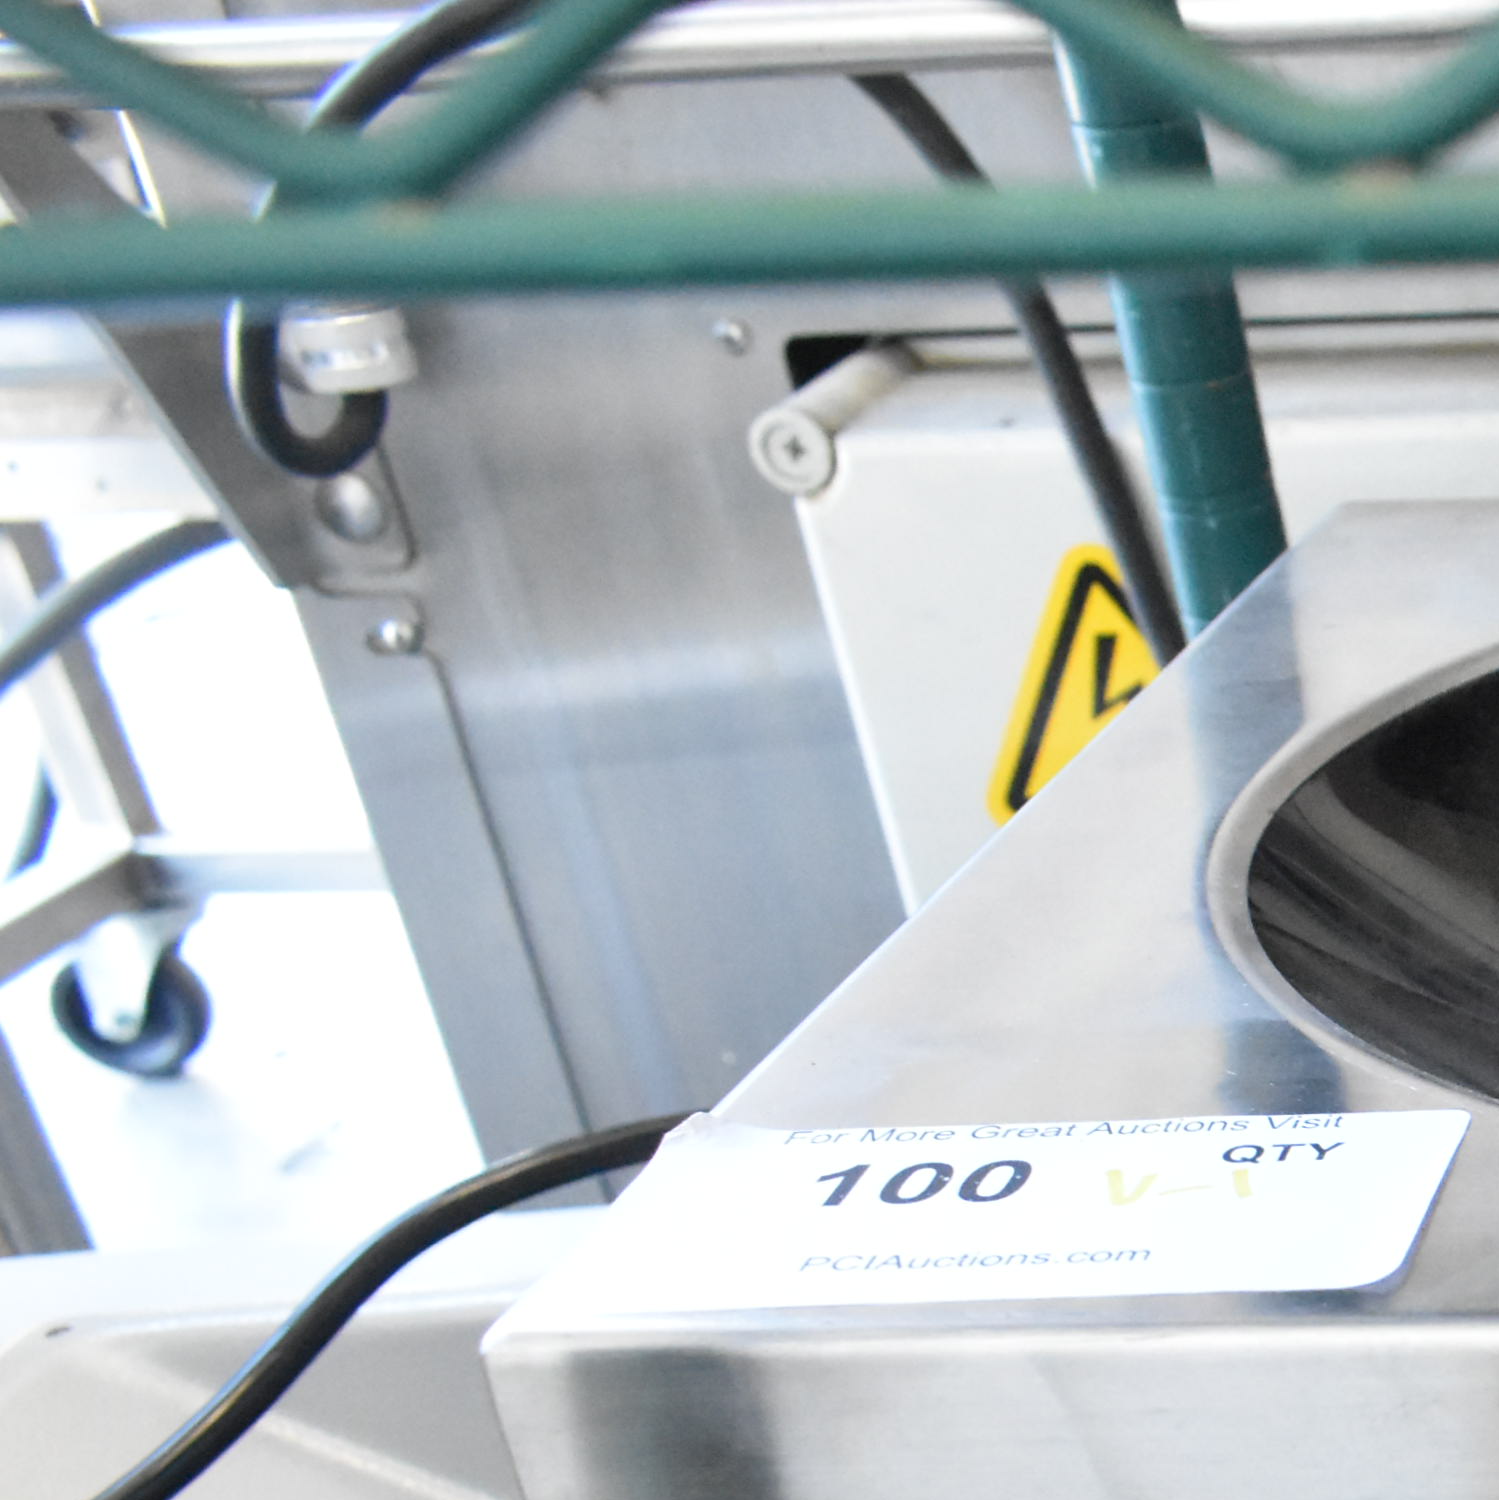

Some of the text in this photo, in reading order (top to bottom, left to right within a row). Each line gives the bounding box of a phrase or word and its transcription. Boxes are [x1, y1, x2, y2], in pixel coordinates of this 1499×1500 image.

[784, 1115, 1345, 1145] For More Great Auctions Visit
[1222, 1142, 1345, 1164] QTY
[817, 1159, 1033, 1207] 100
[799, 1248, 1151, 1273] PCIAuctions.com
